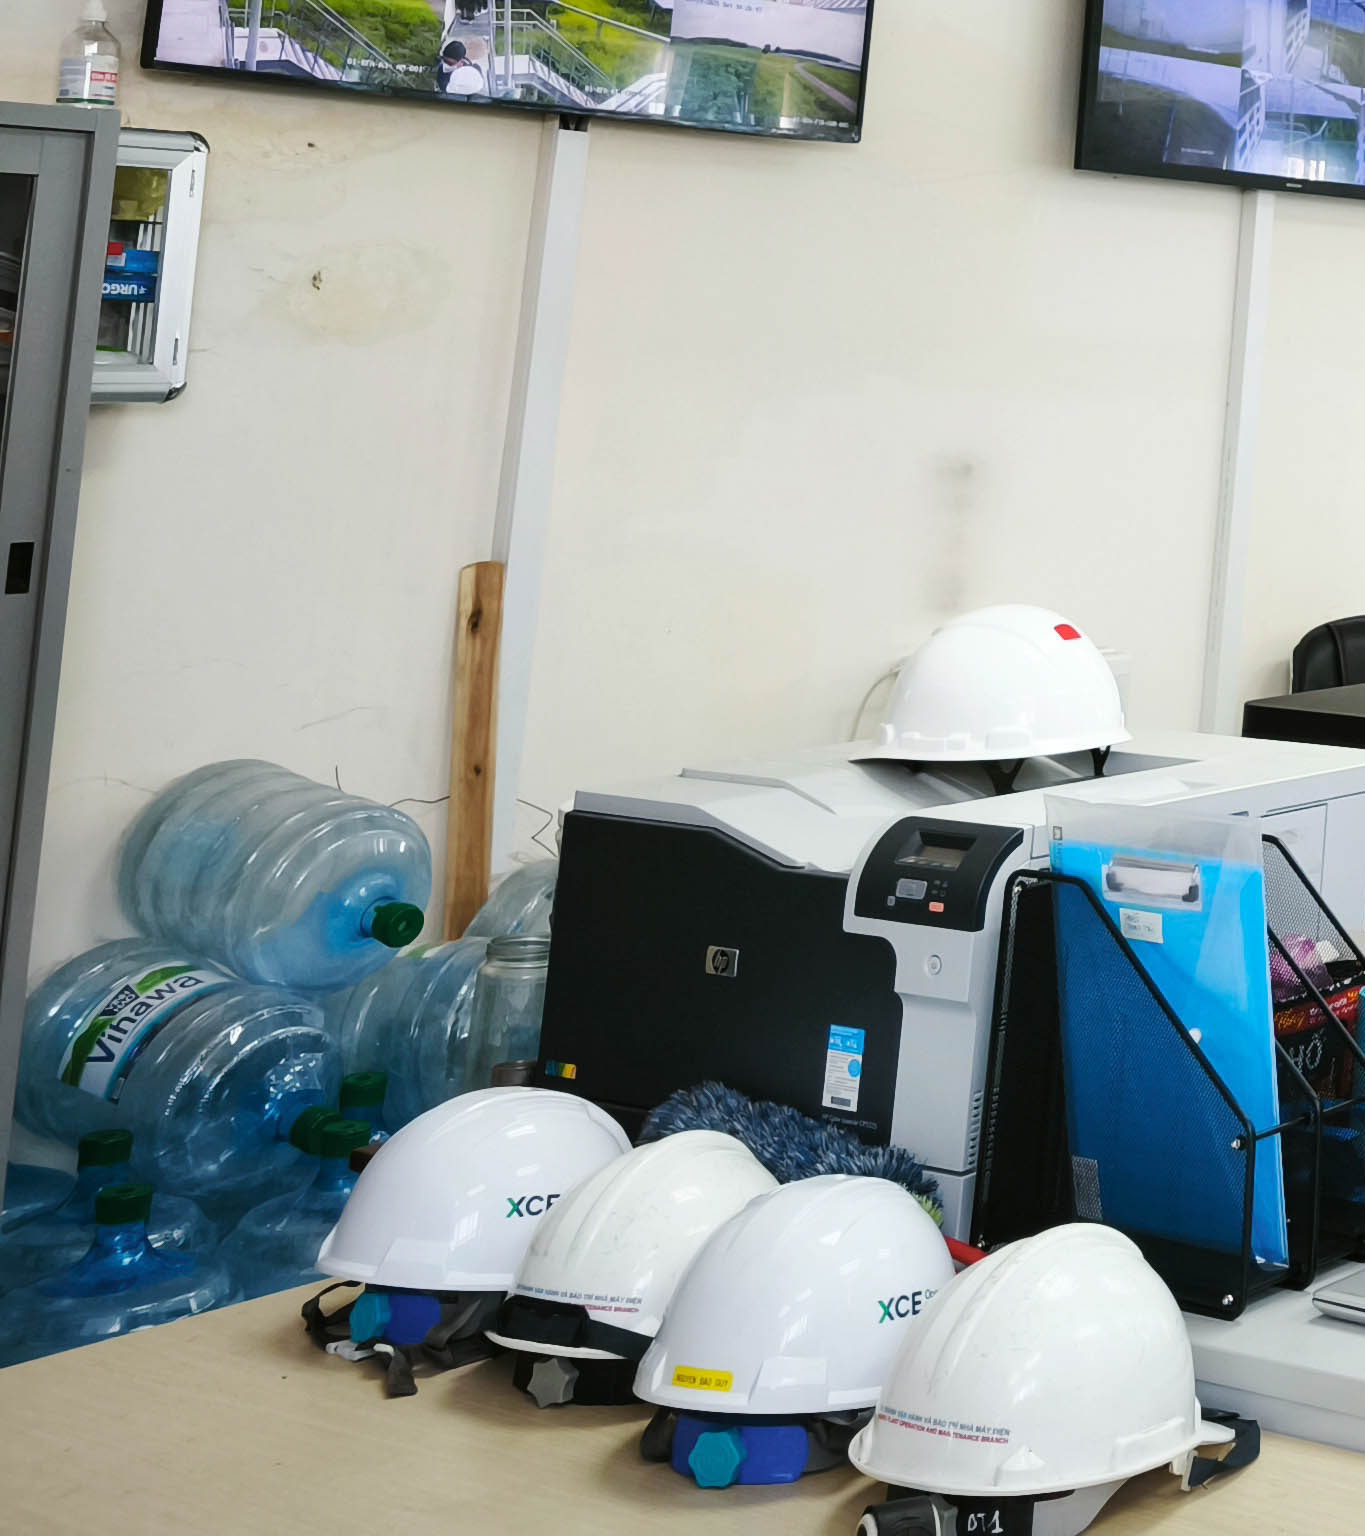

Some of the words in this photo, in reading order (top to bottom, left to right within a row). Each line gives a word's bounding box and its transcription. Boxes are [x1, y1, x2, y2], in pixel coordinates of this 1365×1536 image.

[102, 282, 138, 295] URGO
[84, 975, 204, 1064] Vihawa
[877, 1290, 923, 1324] XCE
